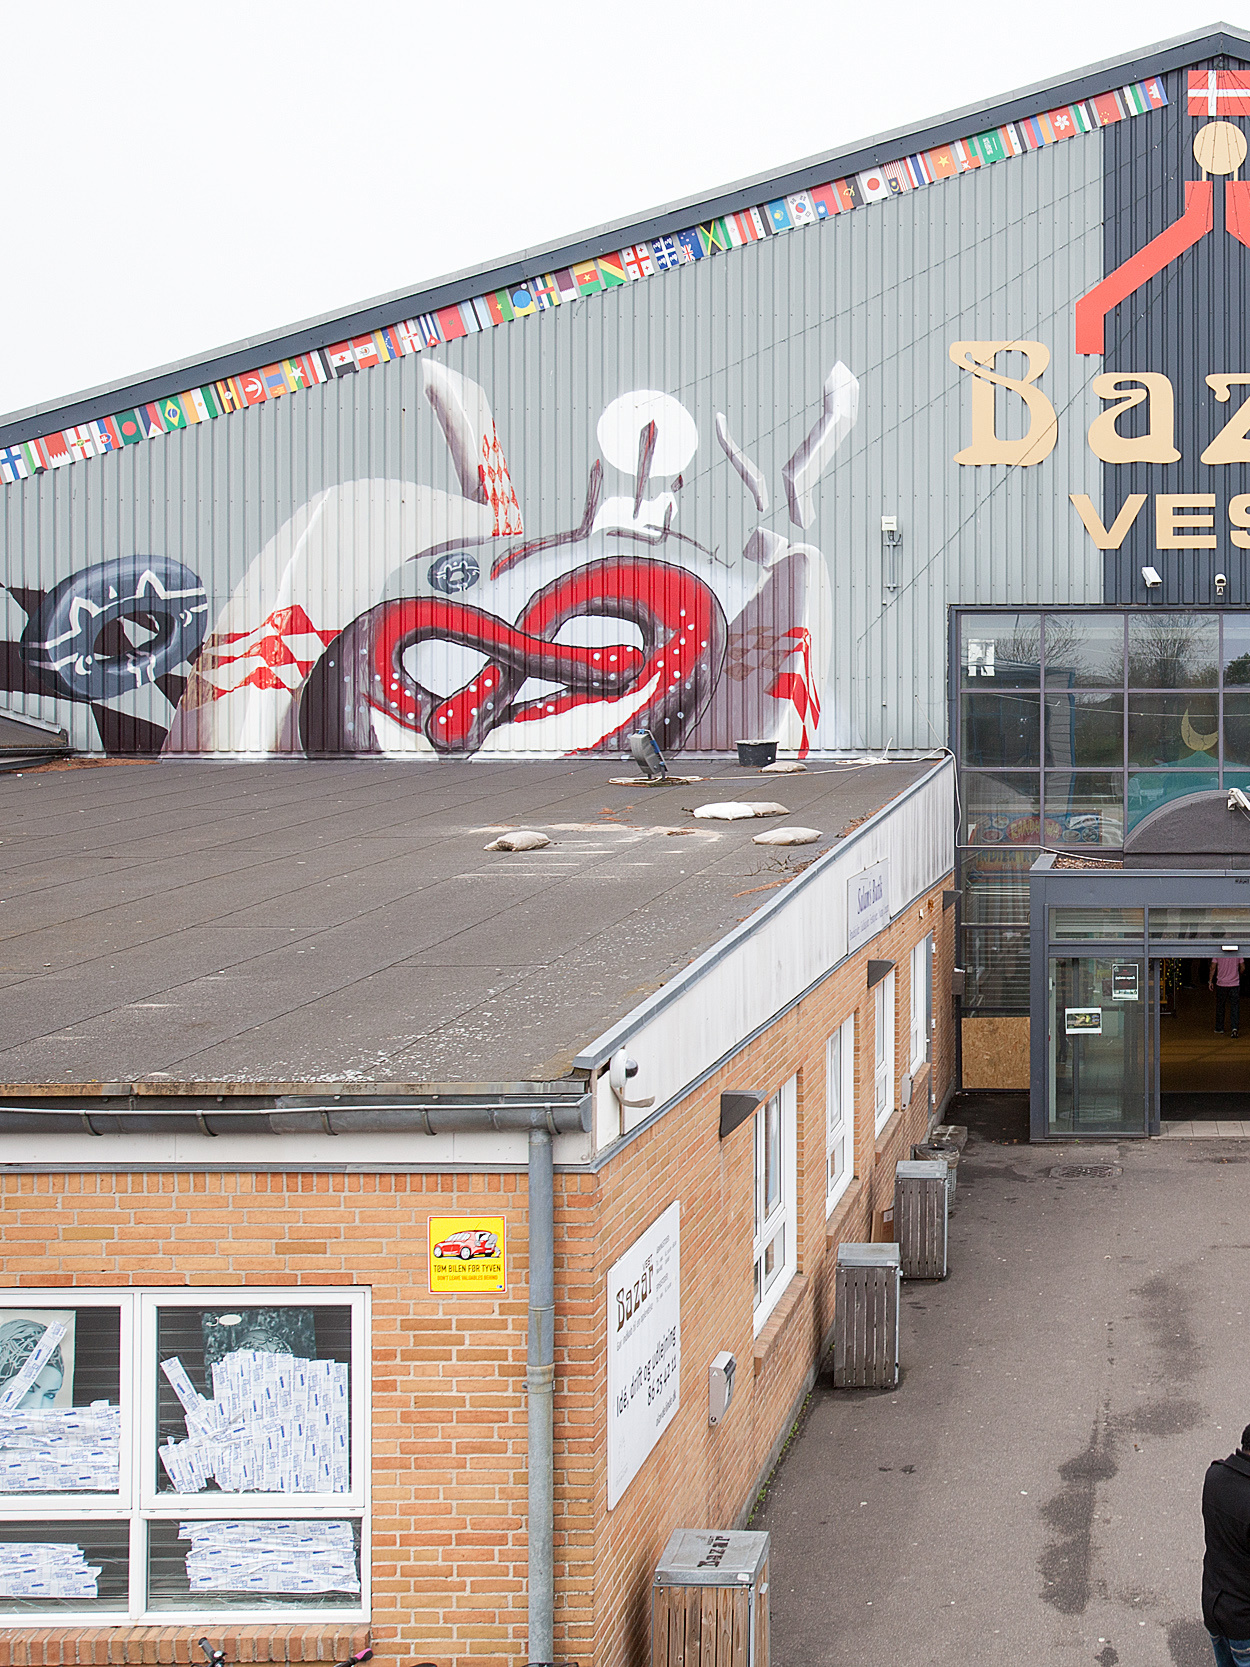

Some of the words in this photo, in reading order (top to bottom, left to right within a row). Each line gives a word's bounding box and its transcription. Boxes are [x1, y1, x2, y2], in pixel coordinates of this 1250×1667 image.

[434, 1264, 447, 1273] TØM
[448, 1264, 466, 1273] BILEN
[468, 1264, 480, 1273] FØR
[482, 1264, 501, 1273] TYVEN
[616, 1264, 654, 1333] Bazar
[630, 1366, 643, 1400] drift
[643, 1359, 651, 1382] og
[652, 1325, 677, 1371] udlejning
[647, 1378, 655, 1407] 86
[656, 1373, 663, 1395] 25
[664, 1361, 671, 1387] 42
[671, 1353, 677, 1373] 11
[697, 1535, 730, 1568] Bazar
